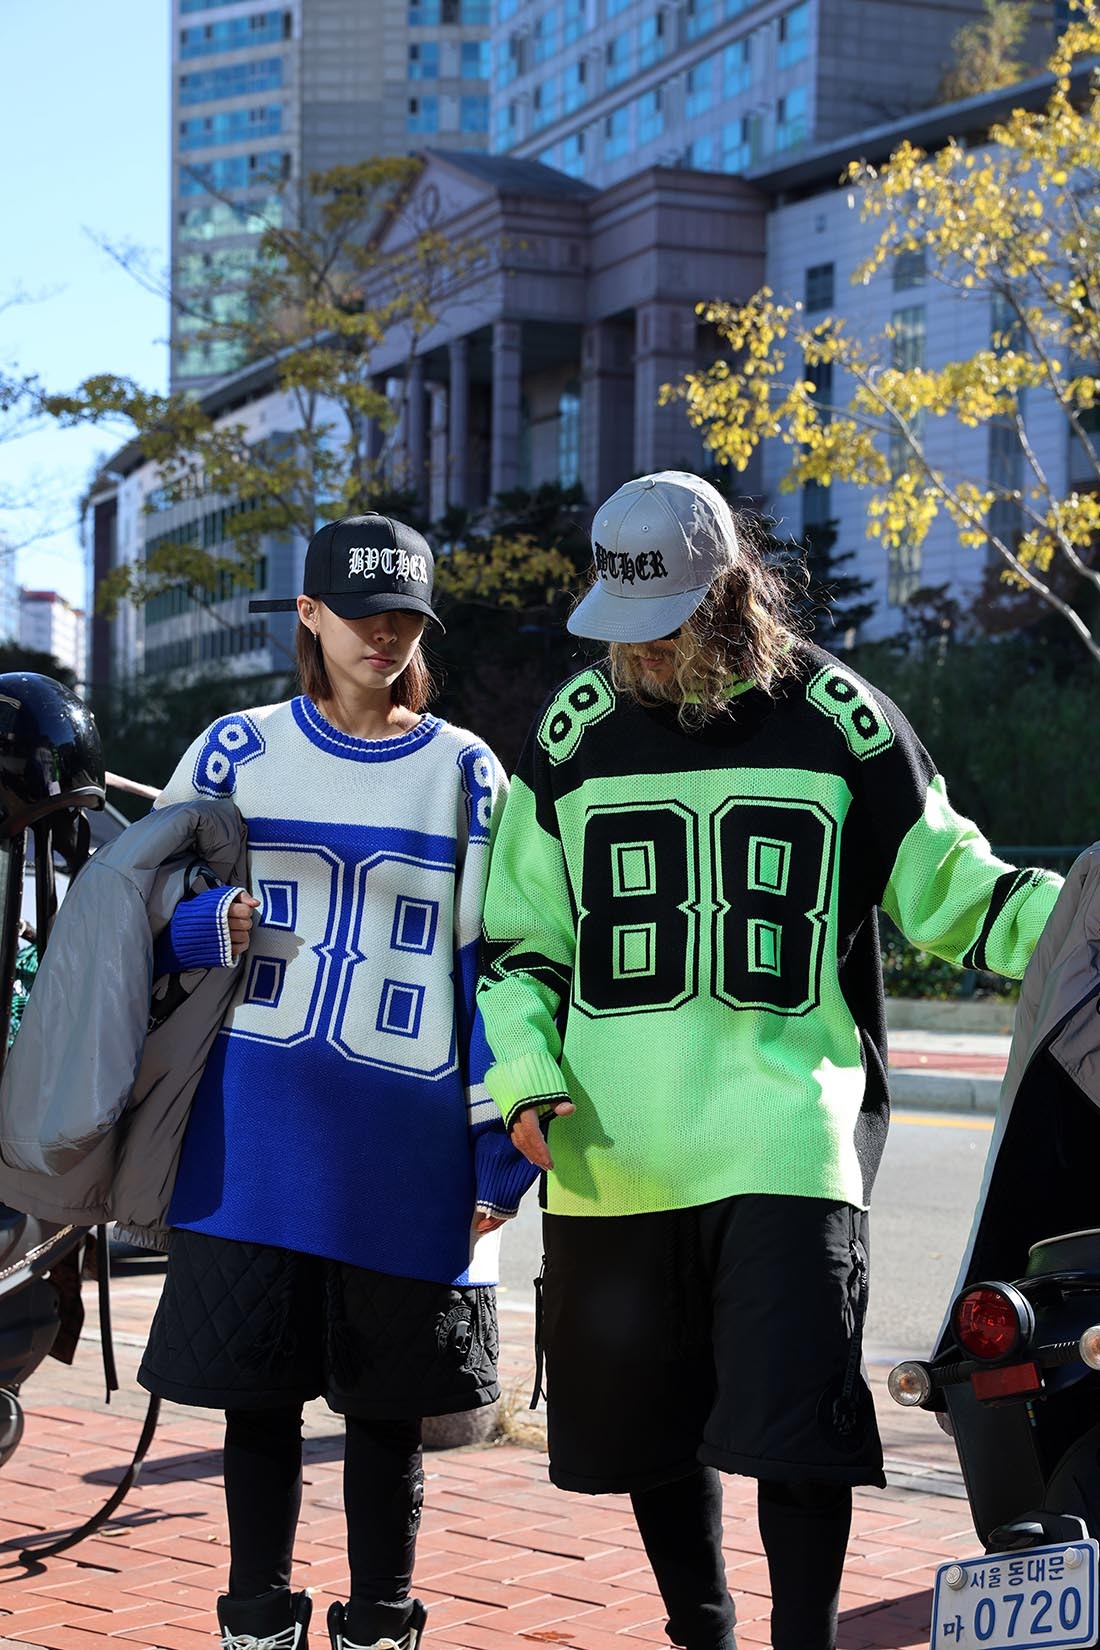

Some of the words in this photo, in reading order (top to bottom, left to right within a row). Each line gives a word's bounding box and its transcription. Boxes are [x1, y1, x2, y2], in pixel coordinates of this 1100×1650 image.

[348, 547, 428, 585] BYTHER
[219, 842, 459, 1081] 88
[572, 796, 838, 1019] 88
[943, 1615, 964, 1642] 마
[974, 1587, 1081, 1641] 0720
